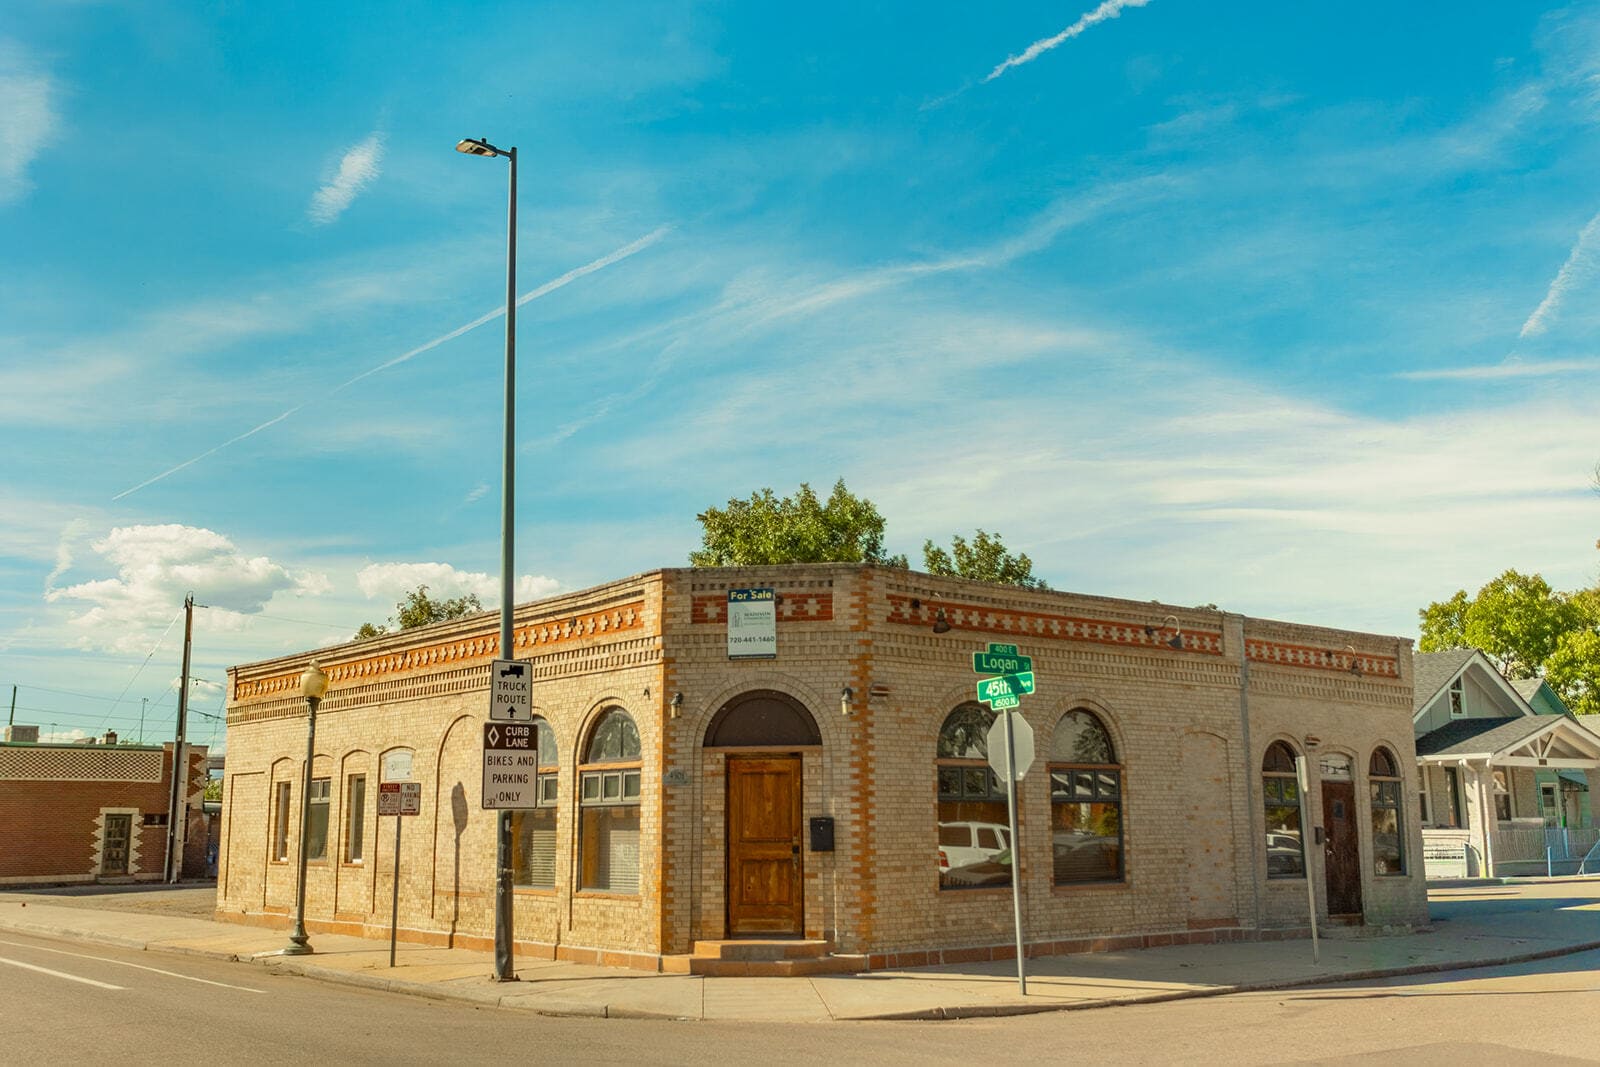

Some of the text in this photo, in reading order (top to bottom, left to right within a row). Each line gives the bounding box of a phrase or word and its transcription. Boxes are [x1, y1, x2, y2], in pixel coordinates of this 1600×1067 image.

[731, 590, 772, 600] For Sale
[730, 635, 775, 644] 720-441-1460
[982, 654, 1018, 673] Logan
[497, 681, 527, 692] TRUCK
[985, 680, 1012, 697] 45th
[496, 694, 527, 705] ROUTE
[505, 726, 530, 736] CURB
[506, 738, 529, 748] LANE
[487, 755, 534, 766] BIKES AND
[492, 773, 529, 784] PARKING
[499, 791, 521, 802] ONLY
